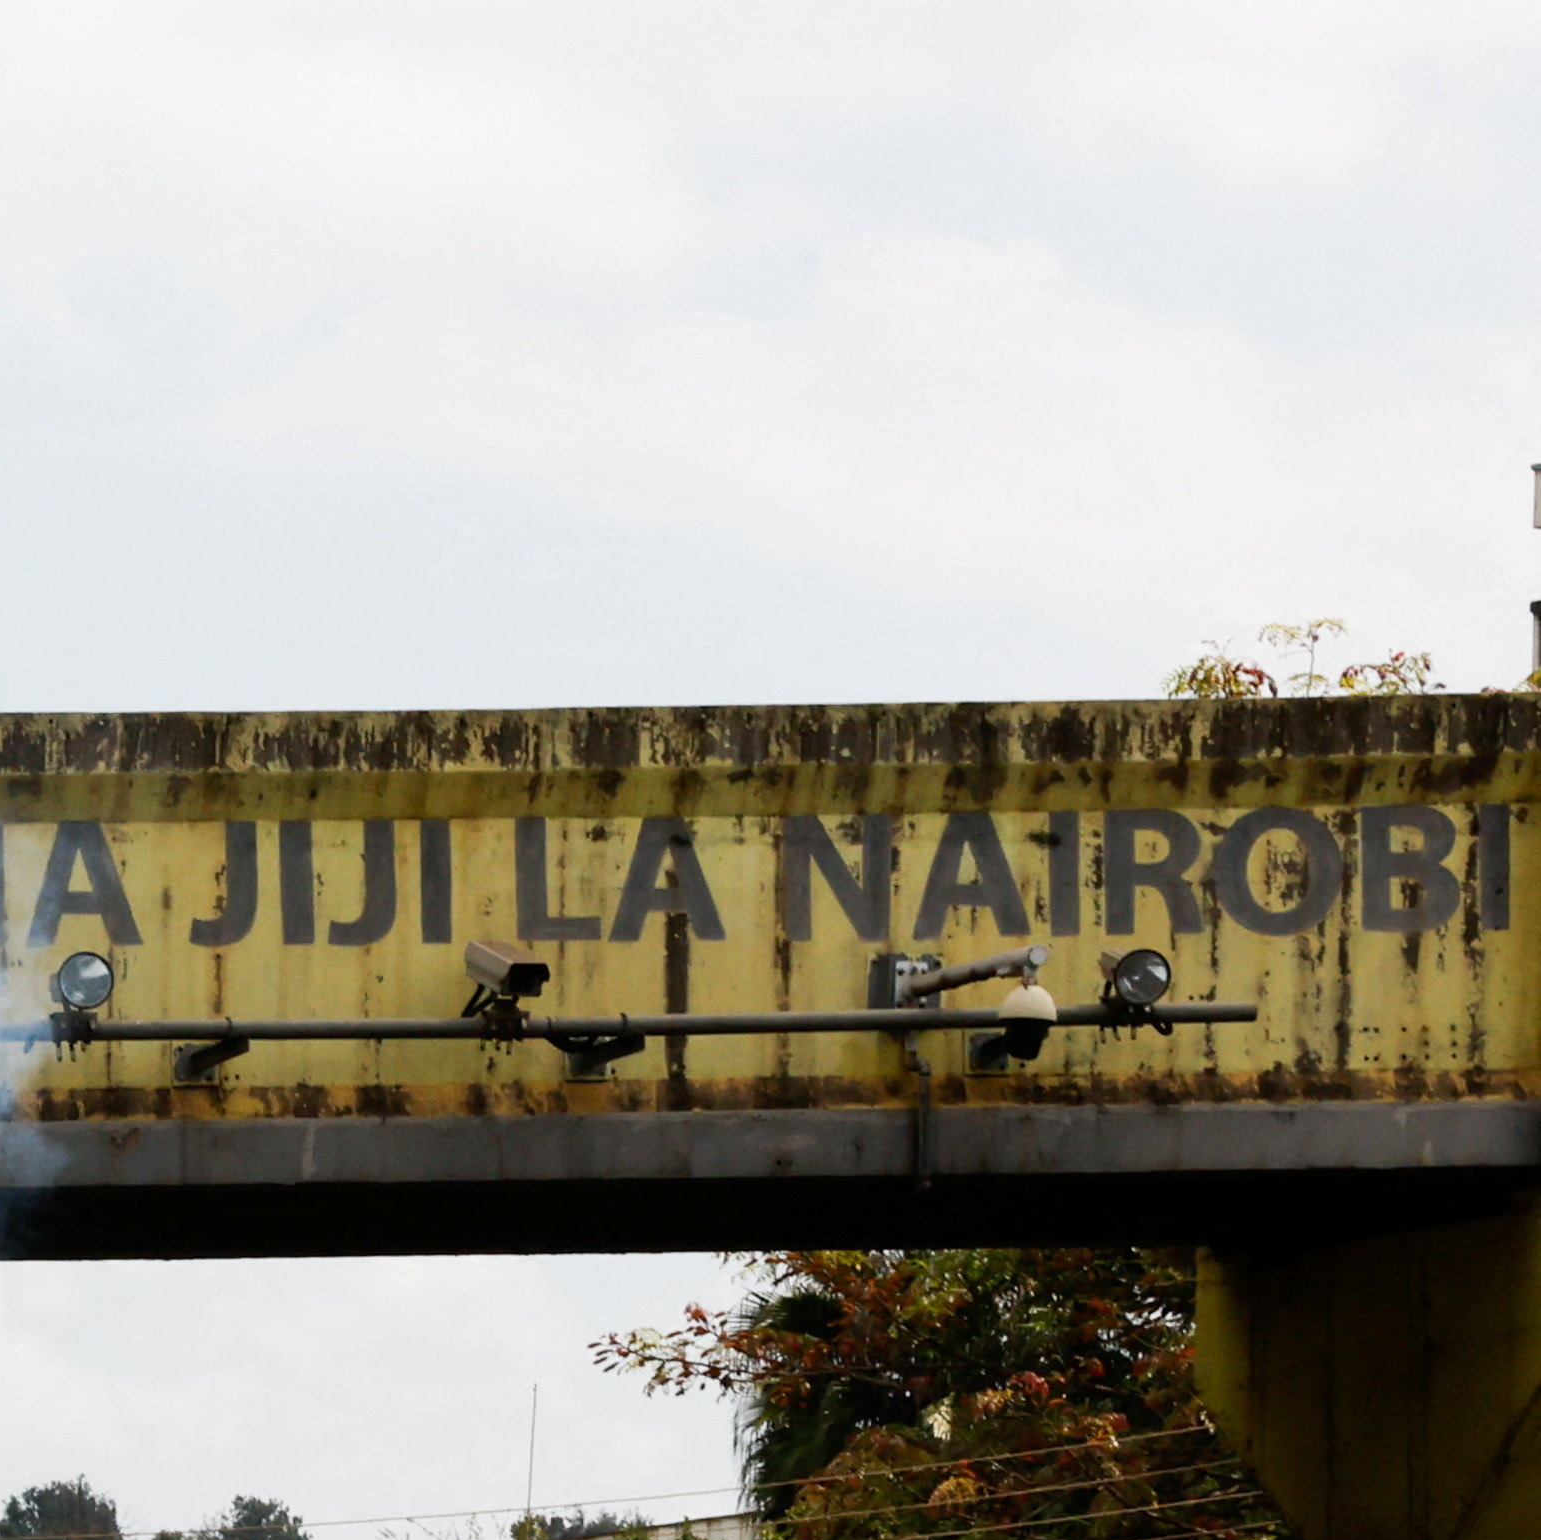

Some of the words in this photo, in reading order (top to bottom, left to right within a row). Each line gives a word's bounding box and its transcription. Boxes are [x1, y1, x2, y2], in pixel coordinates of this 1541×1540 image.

[189, 817, 453, 946] JIJI
[514, 815, 727, 942] LA
[781, 803, 1512, 943] NAIROBI
